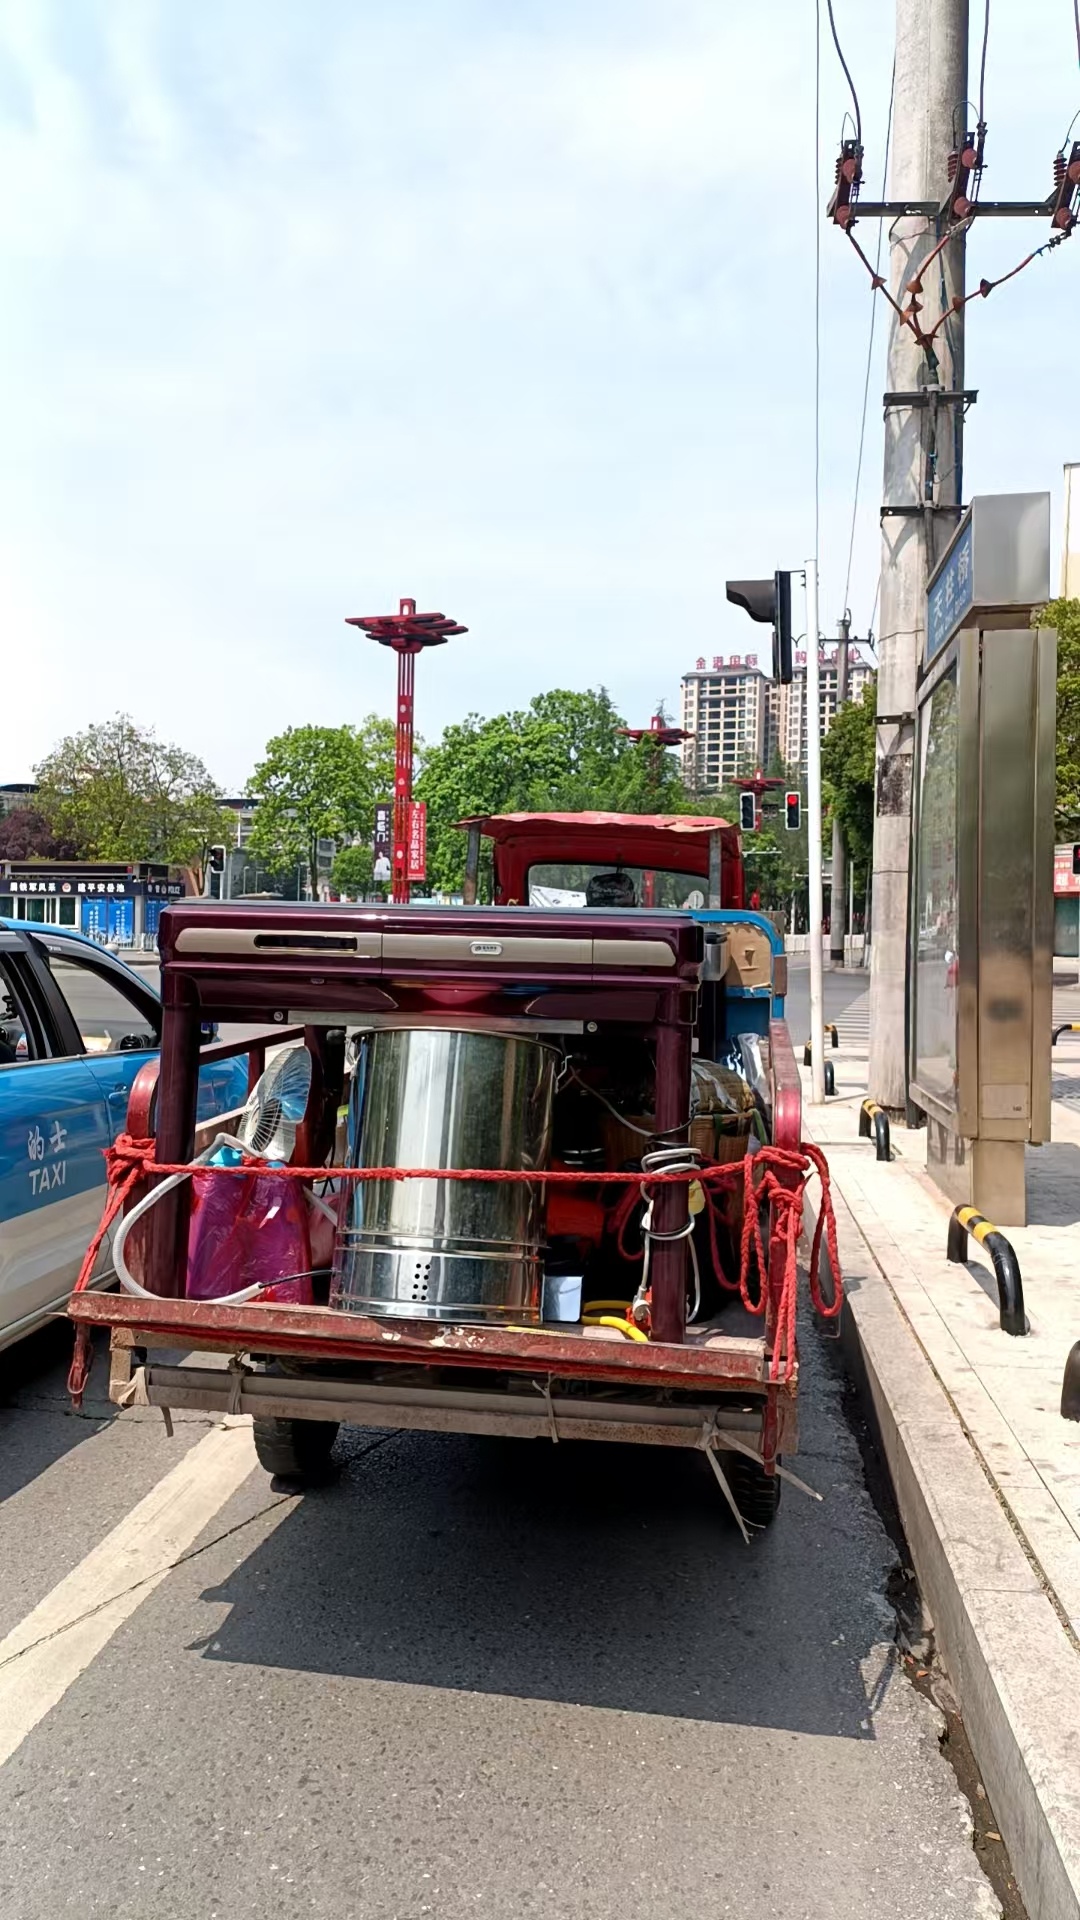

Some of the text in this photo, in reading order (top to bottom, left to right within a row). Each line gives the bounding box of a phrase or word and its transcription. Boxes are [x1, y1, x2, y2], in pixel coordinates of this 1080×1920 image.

[167, 885, 181, 895] POLICE
[28, 1120, 67, 1160] 的士
[28, 1160, 66, 1196] TAXI
